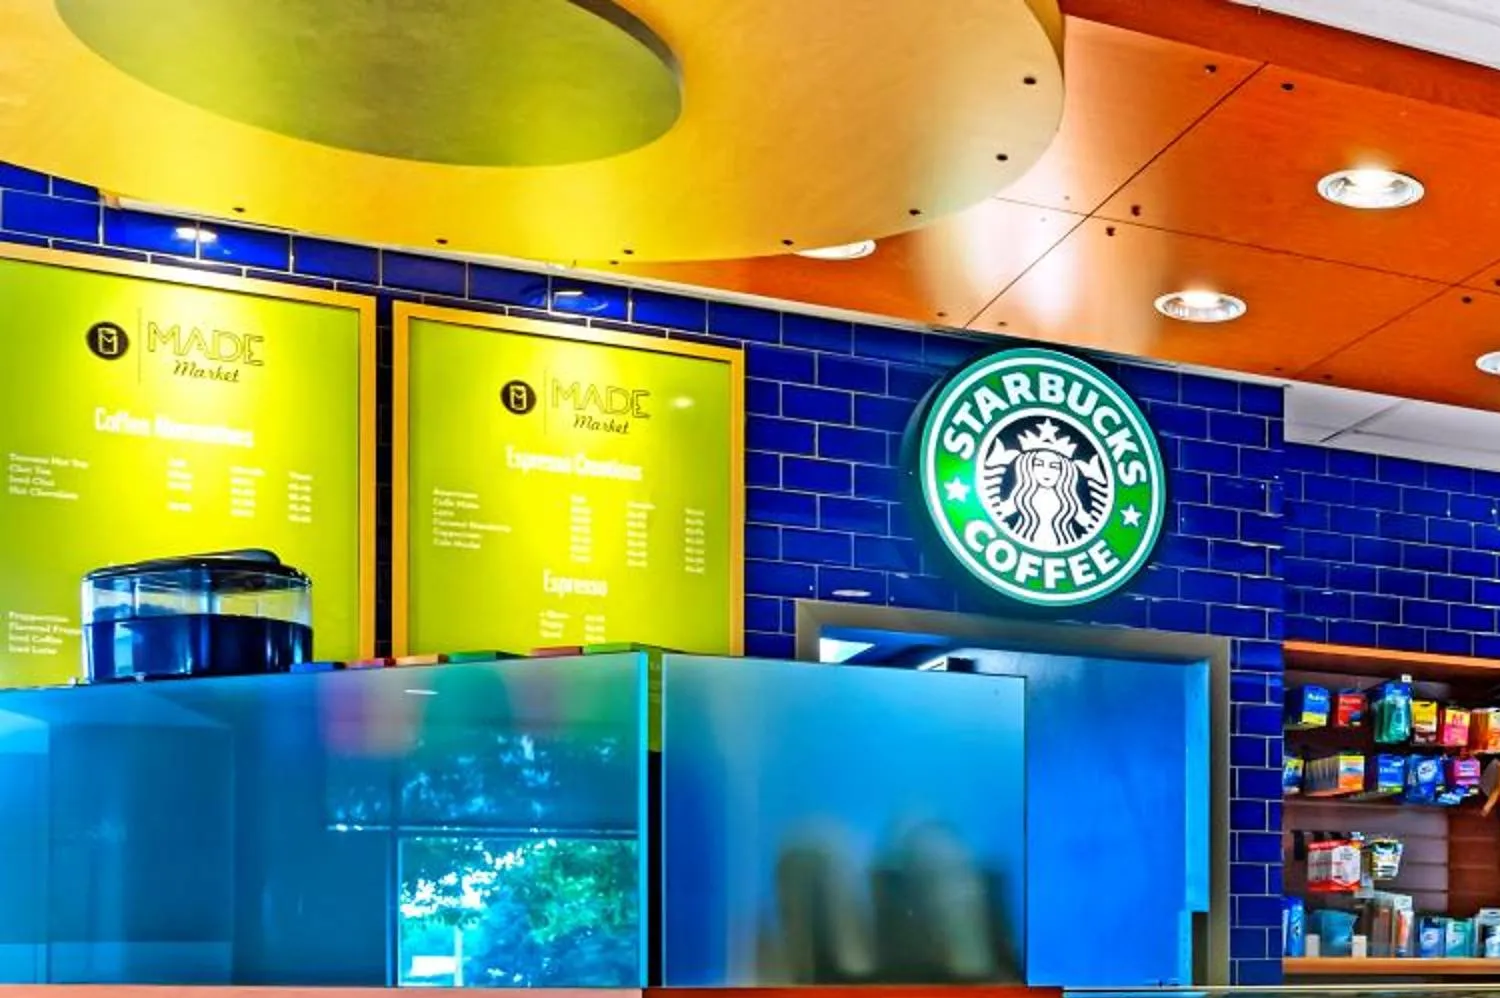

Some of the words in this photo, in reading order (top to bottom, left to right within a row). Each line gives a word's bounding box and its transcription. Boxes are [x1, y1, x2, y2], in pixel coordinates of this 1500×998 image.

[147, 321, 265, 367] MADE
[173, 359, 240, 383] Market
[551, 378, 652, 419] MADE
[573, 413, 630, 435] Market
[943, 371, 1147, 486] STARBUCKS
[964, 519, 1120, 590] COFFEE
